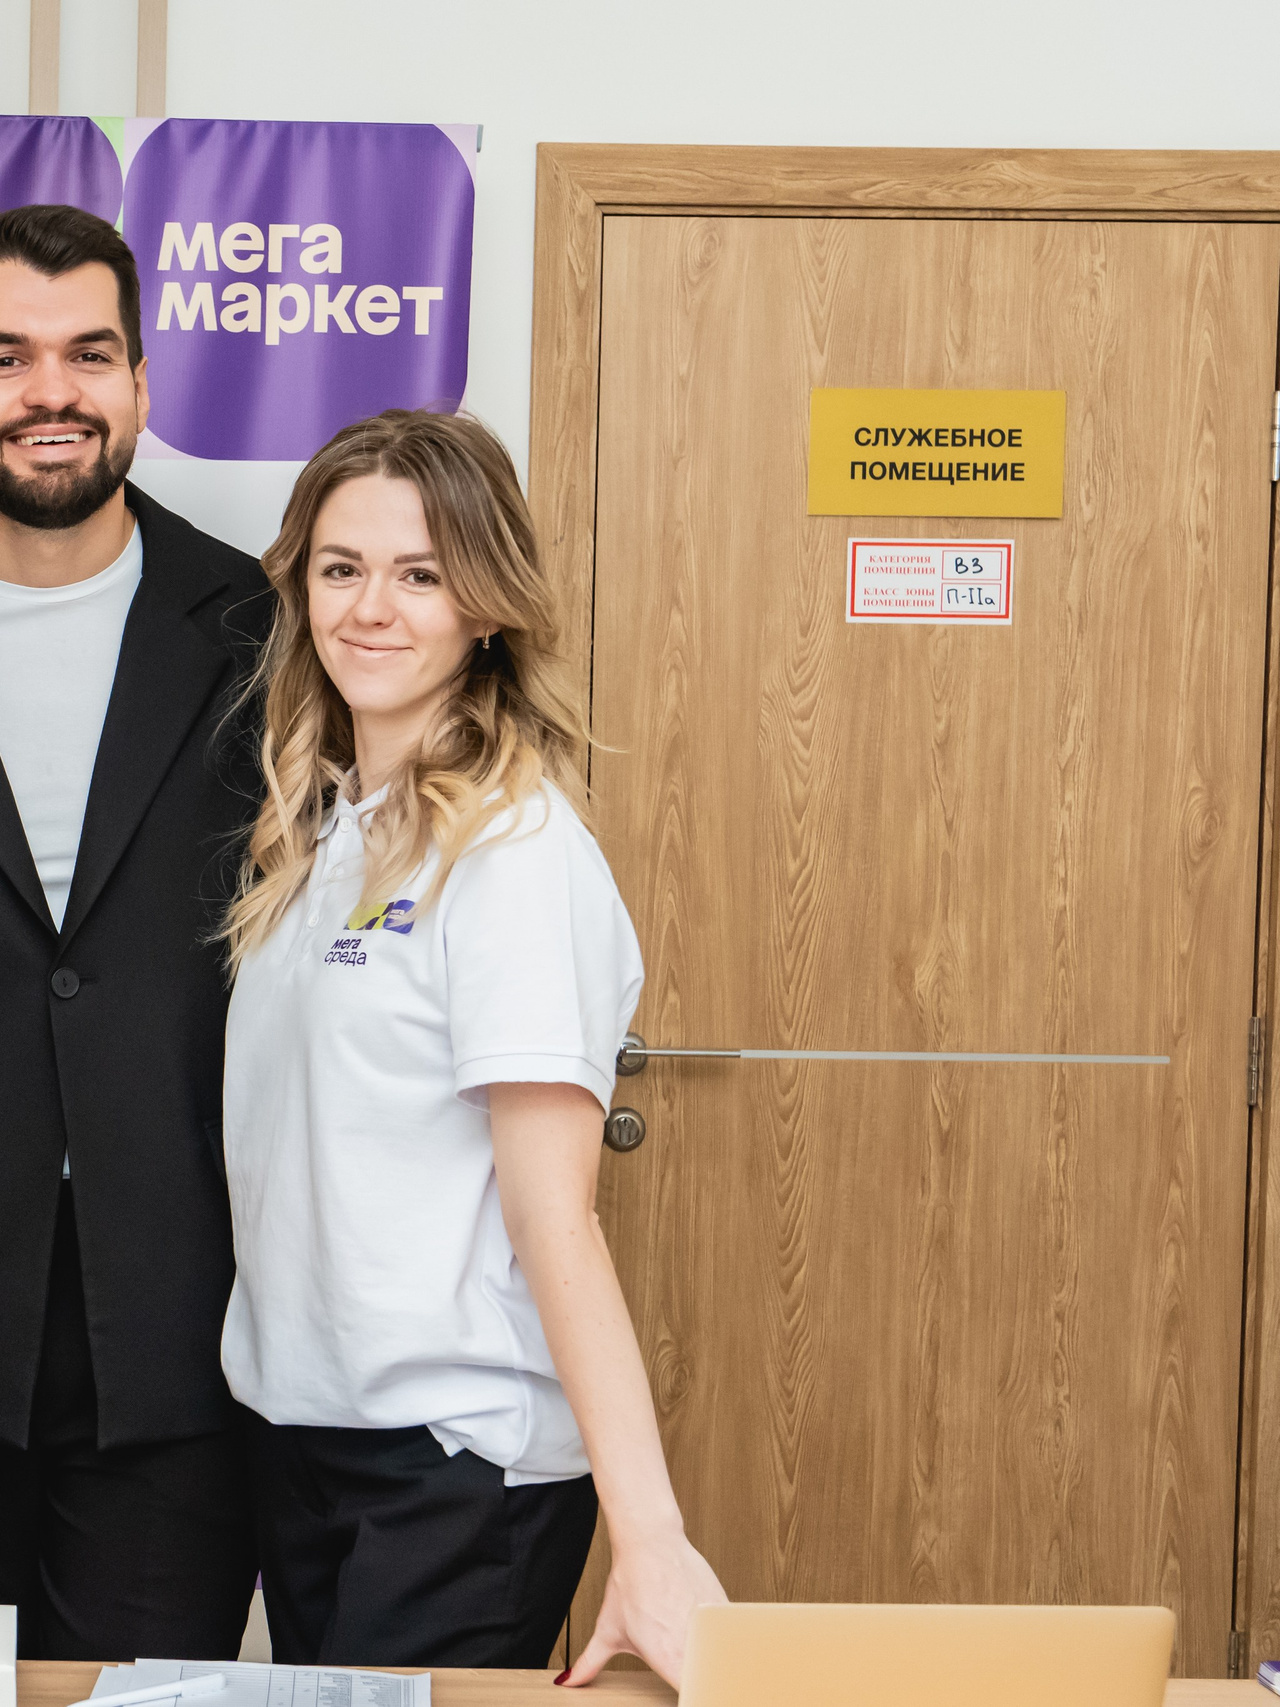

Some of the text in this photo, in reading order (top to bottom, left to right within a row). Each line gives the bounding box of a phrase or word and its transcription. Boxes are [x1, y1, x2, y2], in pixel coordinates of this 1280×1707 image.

[157, 222, 342, 274] мега
[156, 281, 443, 345] маркет
[854, 427, 1023, 448] СЛУЖЕБНОЕ
[850, 461, 1025, 485] ПОМЕЩЕНИЕ
[869, 555, 931, 564] КАТЕГОРИЯ
[864, 566, 936, 575] ПОМЕЩЕНИЯ
[864, 587, 935, 596] КЛАСС ЗОНЫ
[863, 599, 935, 608] ПОМЕЩЕНИЯ
[331, 938, 362, 949] мега
[324, 951, 367, 966] среда
